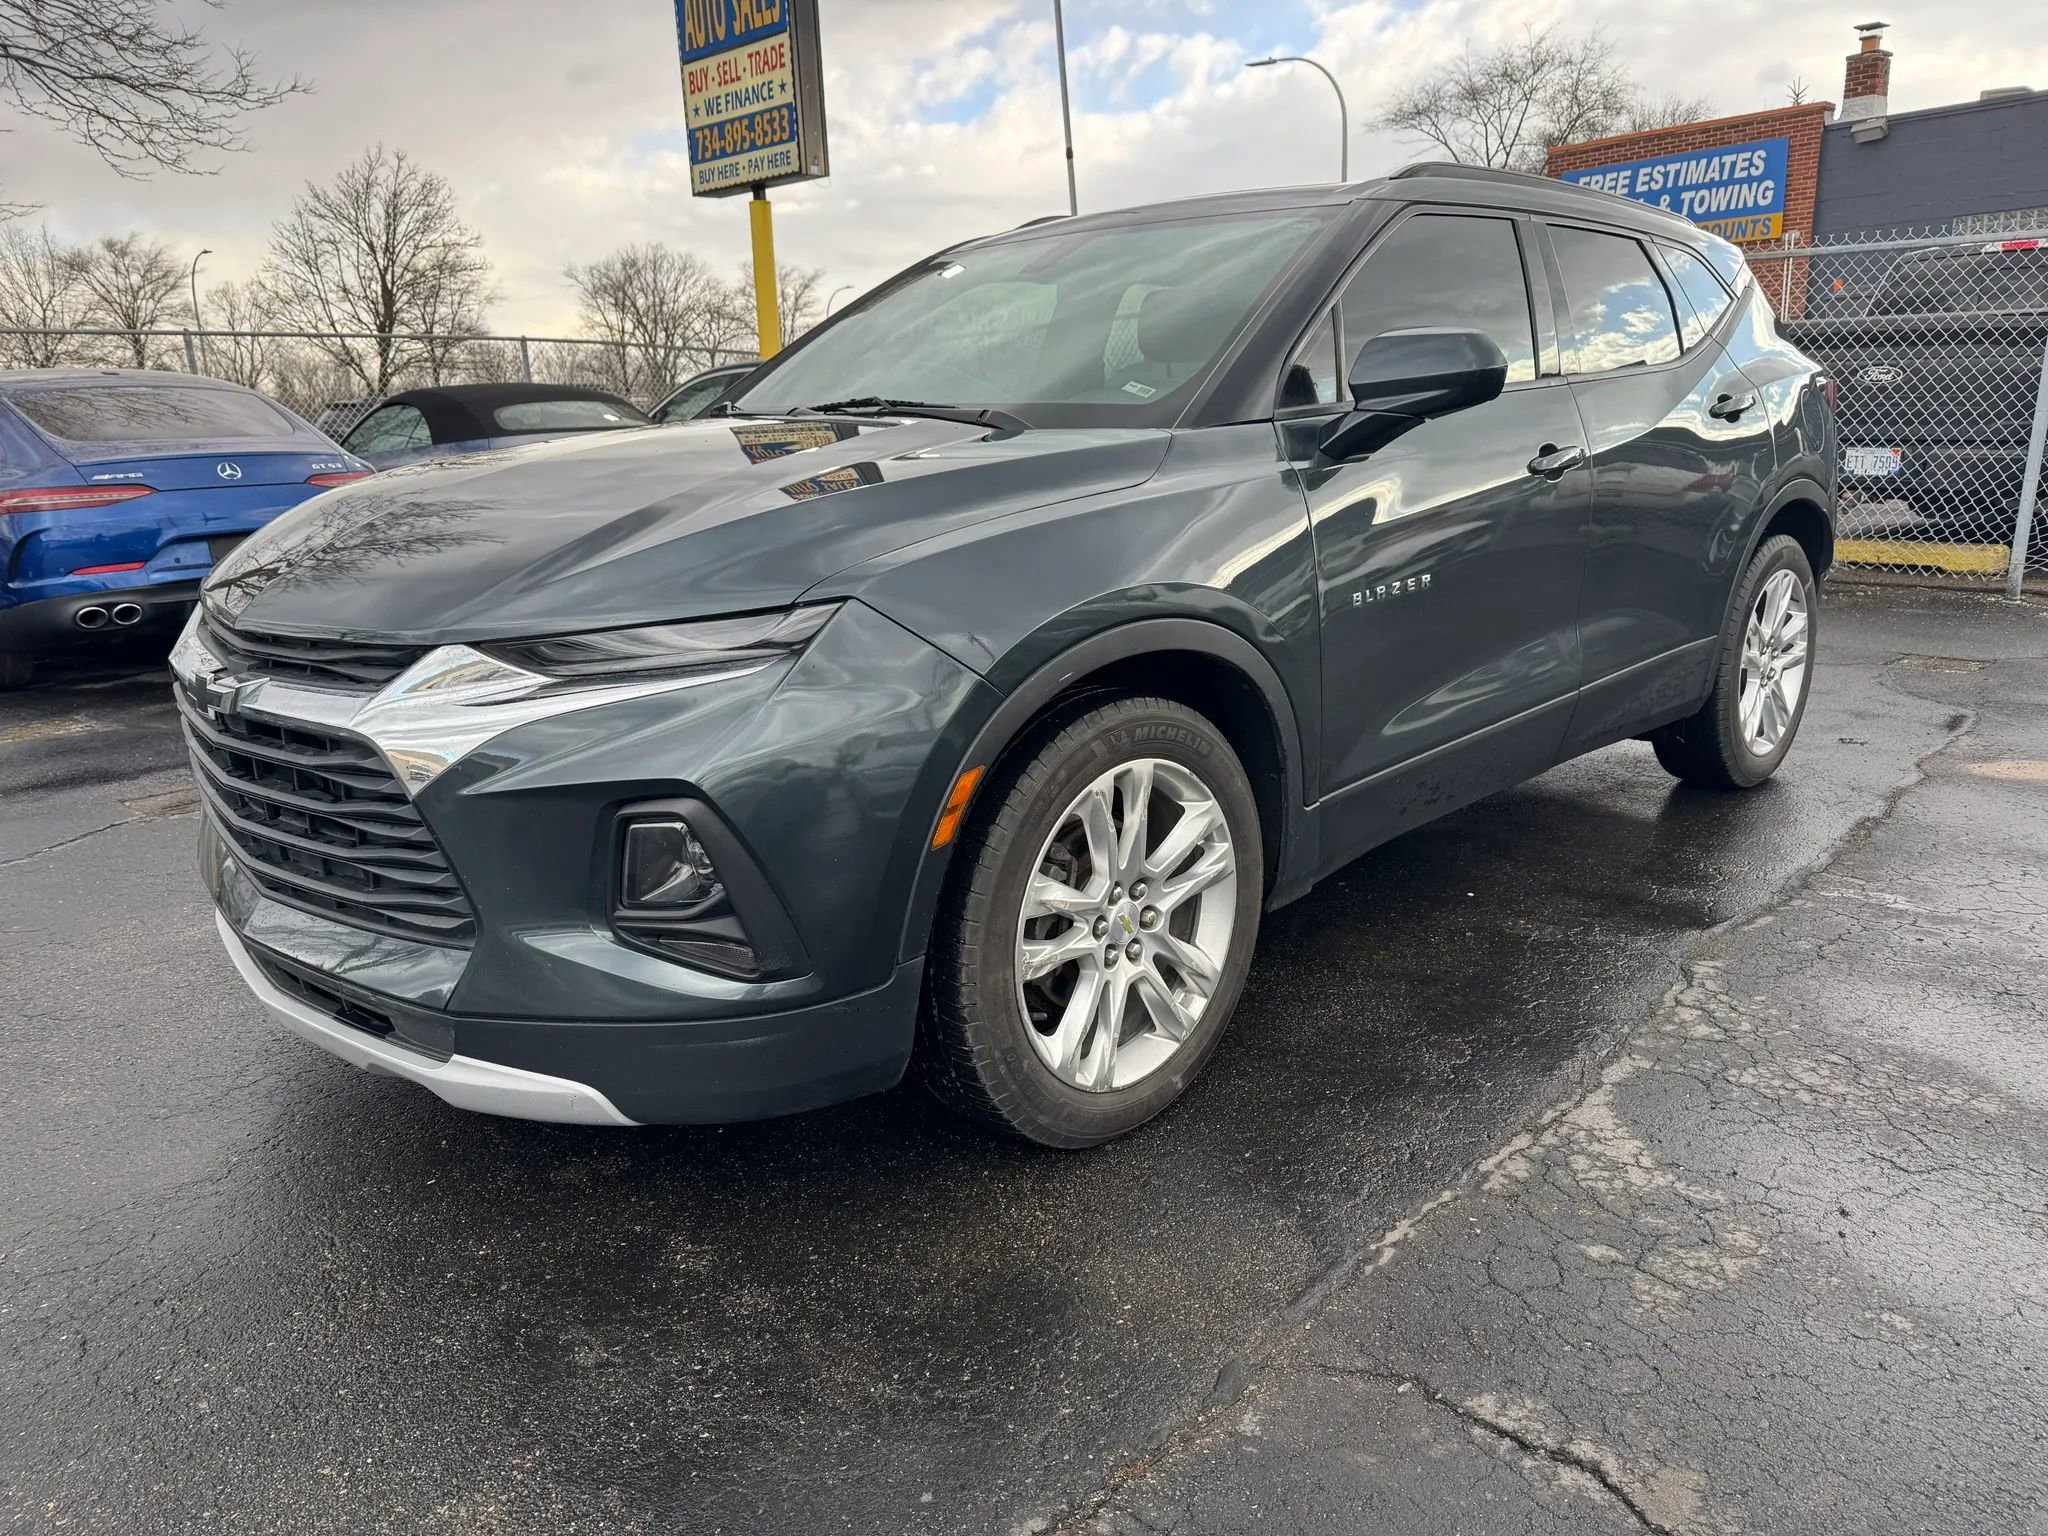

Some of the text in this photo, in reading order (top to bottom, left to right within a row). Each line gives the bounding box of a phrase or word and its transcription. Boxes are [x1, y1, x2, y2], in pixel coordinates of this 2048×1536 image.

[688, 42, 785, 95] BUY SELL TRADE
[704, 80, 774, 116] WE FINANCE
[695, 107, 790, 160] 734-895-8533
[699, 150, 791, 184] BUY HERE PAY HERE
[1579, 150, 1767, 194] FREE ESTIMATES
[1680, 180, 1775, 216] TOWING
[1864, 369, 1894, 381] Ford
[1352, 574, 1431, 606] BLAZER
[1135, 725, 1211, 755] MICHELIN
